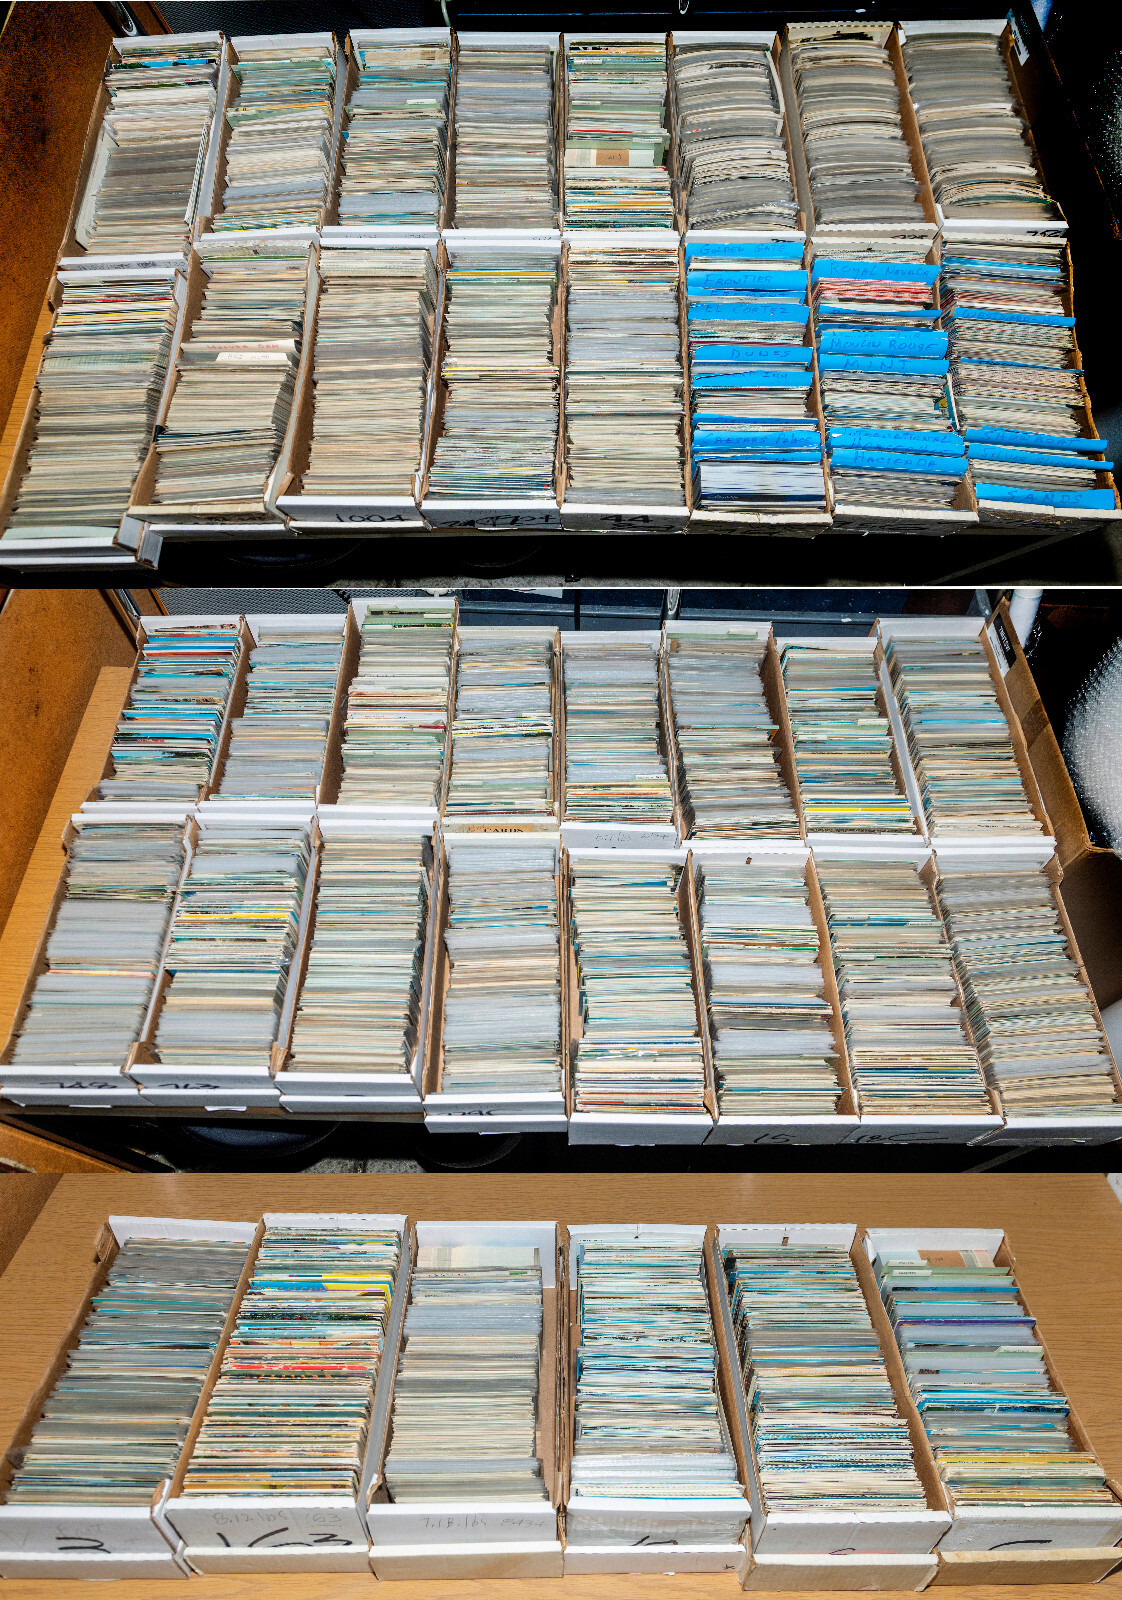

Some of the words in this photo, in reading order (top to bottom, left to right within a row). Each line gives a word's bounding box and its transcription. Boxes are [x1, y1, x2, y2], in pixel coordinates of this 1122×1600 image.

[830, 262, 877, 277] ROYAL
[704, 273, 772, 286] FRONTIER
[831, 339, 881, 350] MOULIN
[731, 348, 791, 359] DUNES
[843, 358, 911, 369] MINT
[854, 451, 938, 467] HACIENDA
[1008, 490, 1083, 504] SANDS
